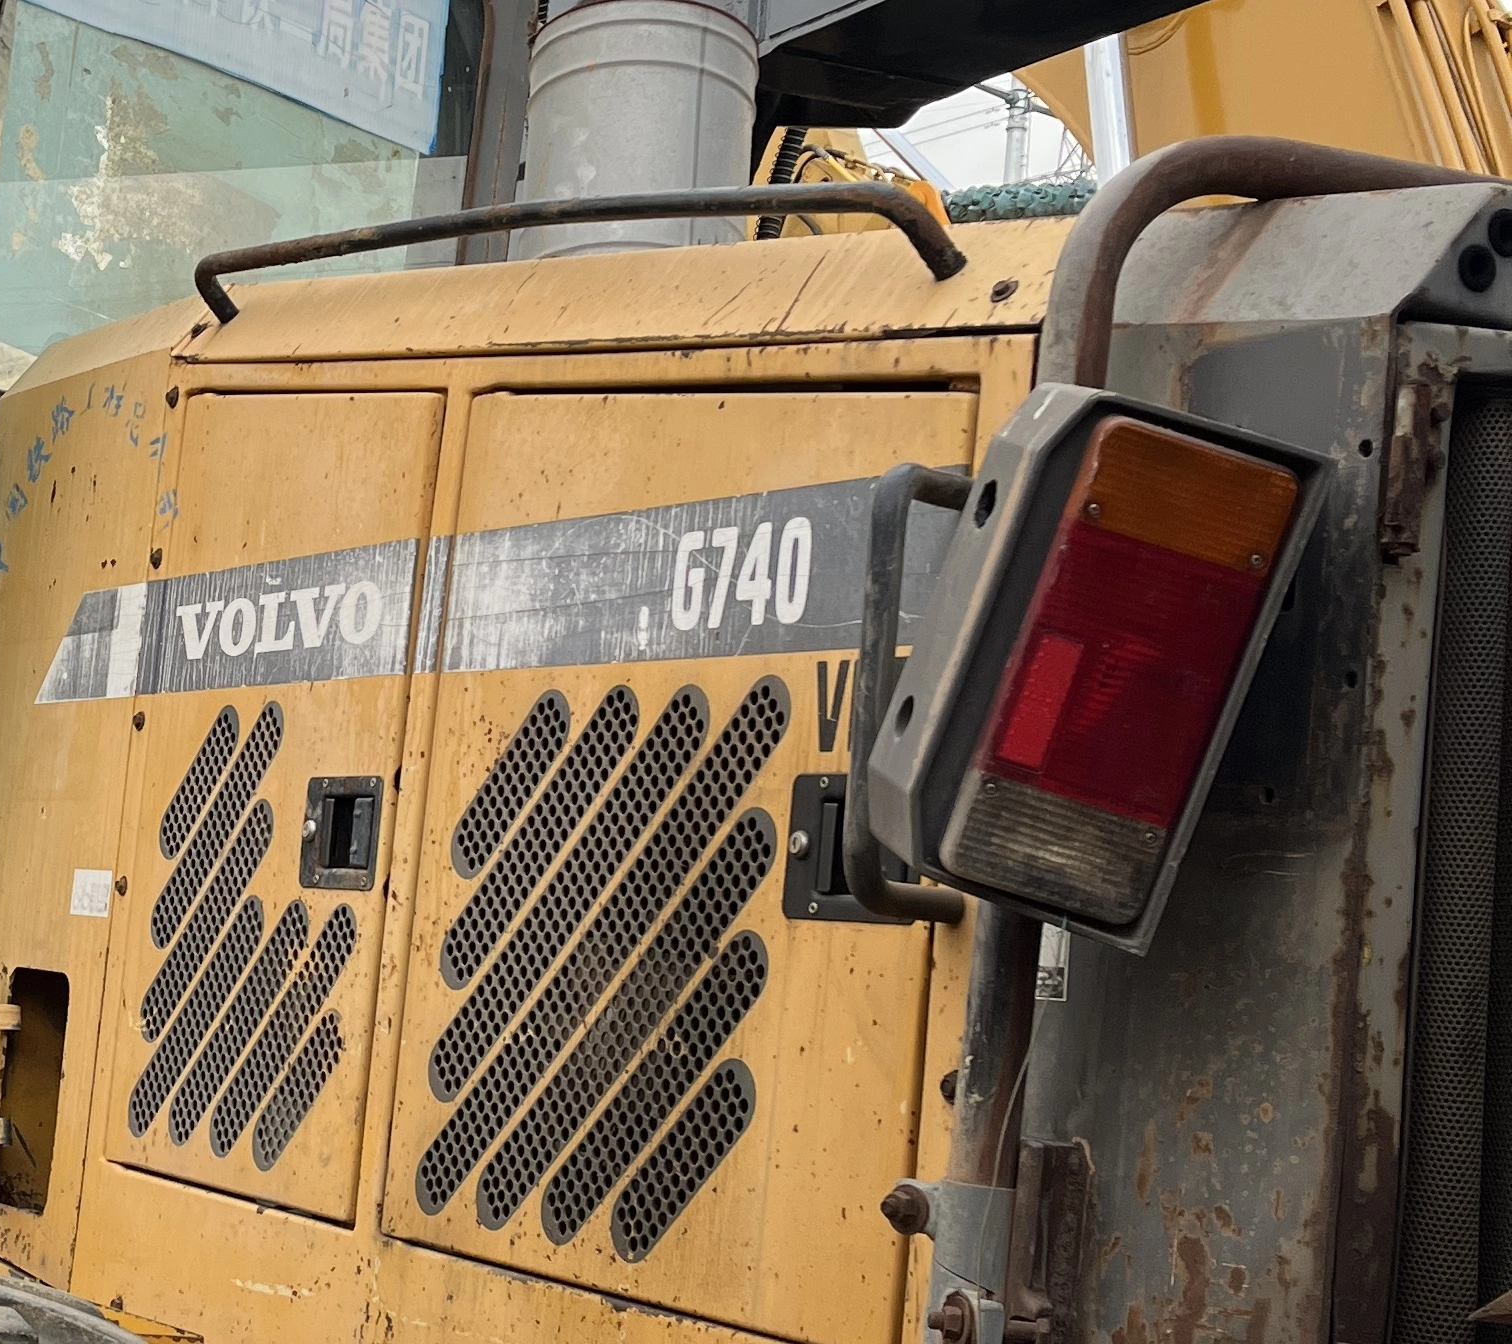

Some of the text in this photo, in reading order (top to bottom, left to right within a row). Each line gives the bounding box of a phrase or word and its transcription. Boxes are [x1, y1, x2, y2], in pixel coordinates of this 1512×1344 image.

[176, 580, 383, 661] VOLVO
[670, 517, 812, 631] G740
[817, 659, 856, 752] V
